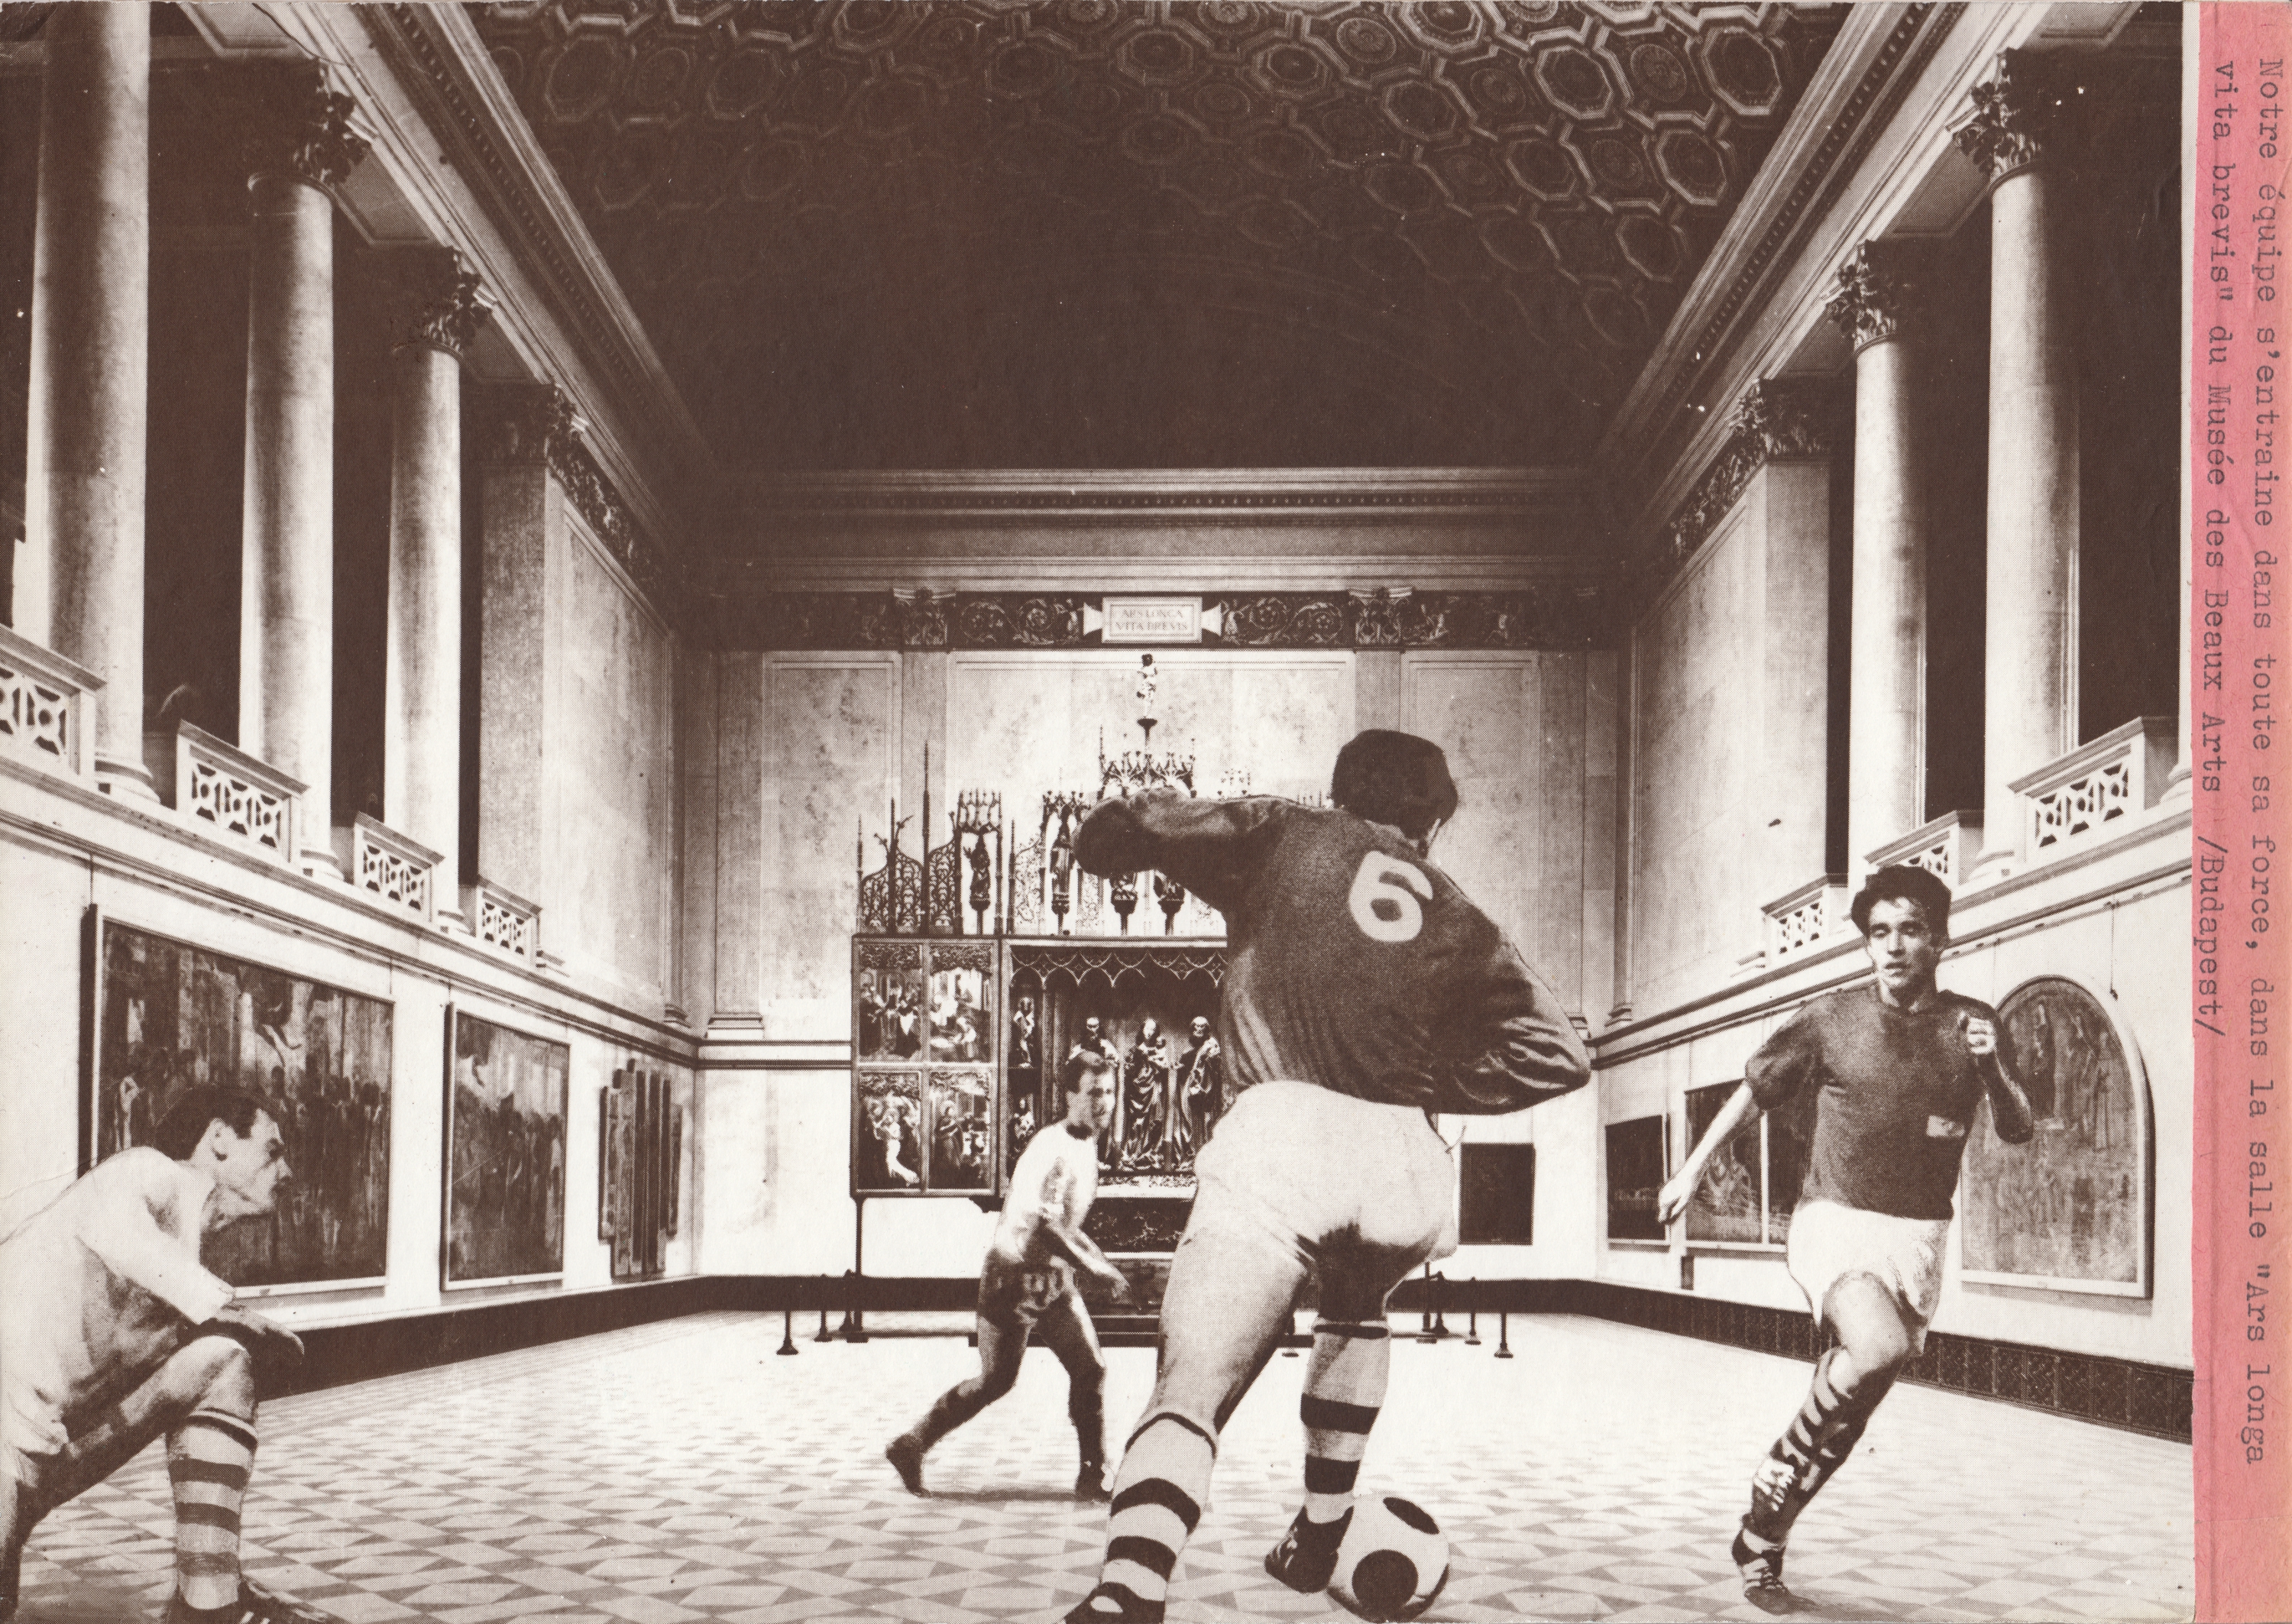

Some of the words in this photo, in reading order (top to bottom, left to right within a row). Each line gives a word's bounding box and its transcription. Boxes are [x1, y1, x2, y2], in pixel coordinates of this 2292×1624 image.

[2213, 60, 2239, 141] vita
[2258, 58, 2284, 159] Notre
[2252, 184, 2286, 302] équipe
[2208, 325, 2233, 365] du
[2206, 384, 2235, 486] Musée
[2205, 509, 2230, 568] des
[2253, 550, 2278, 629] dans
[2203, 589, 2229, 691] Beaux
[2252, 653, 2277, 750] toute
[2202, 711, 2227, 792] Arts
[2252, 775, 2271, 813] sa
[1348, 849, 1434, 943] 6
[2249, 978, 2274, 1056] dans
[2248, 1079, 2274, 1118] la
[2248, 1142, 2273, 1238] salle
[2240, 1364, 2271, 1465] longa
